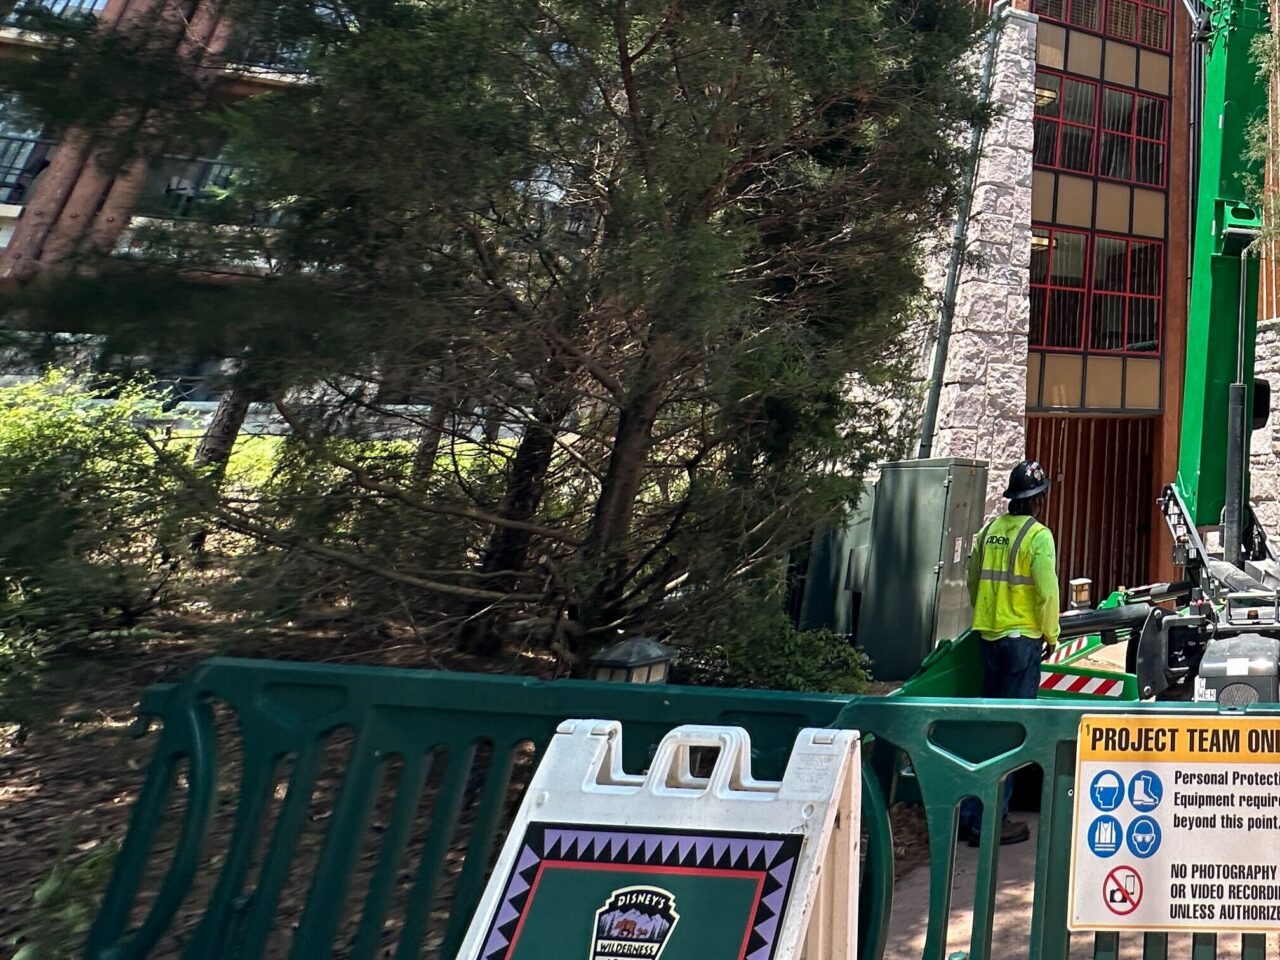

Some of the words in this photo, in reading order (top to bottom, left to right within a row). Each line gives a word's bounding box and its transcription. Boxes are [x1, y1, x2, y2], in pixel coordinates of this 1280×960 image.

[1091, 727, 1179, 752] PROJECT
[1187, 728, 1240, 753] TEAM
[1174, 770, 1228, 786] Personal
[1174, 791, 1235, 809] Equipment
[1173, 813, 1216, 830] beyond
[1221, 814, 1243, 829] this
[1170, 863, 1187, 879] NO
[1191, 864, 1277, 880] PHOTOGRAPHY
[1170, 883, 1186, 899] OR
[1190, 884, 1224, 899] VIDEO
[617, 892, 665, 908] DISNEY'S
[1169, 903, 1215, 919] UNLESS
[600, 942, 655, 955] WILDERNESS
